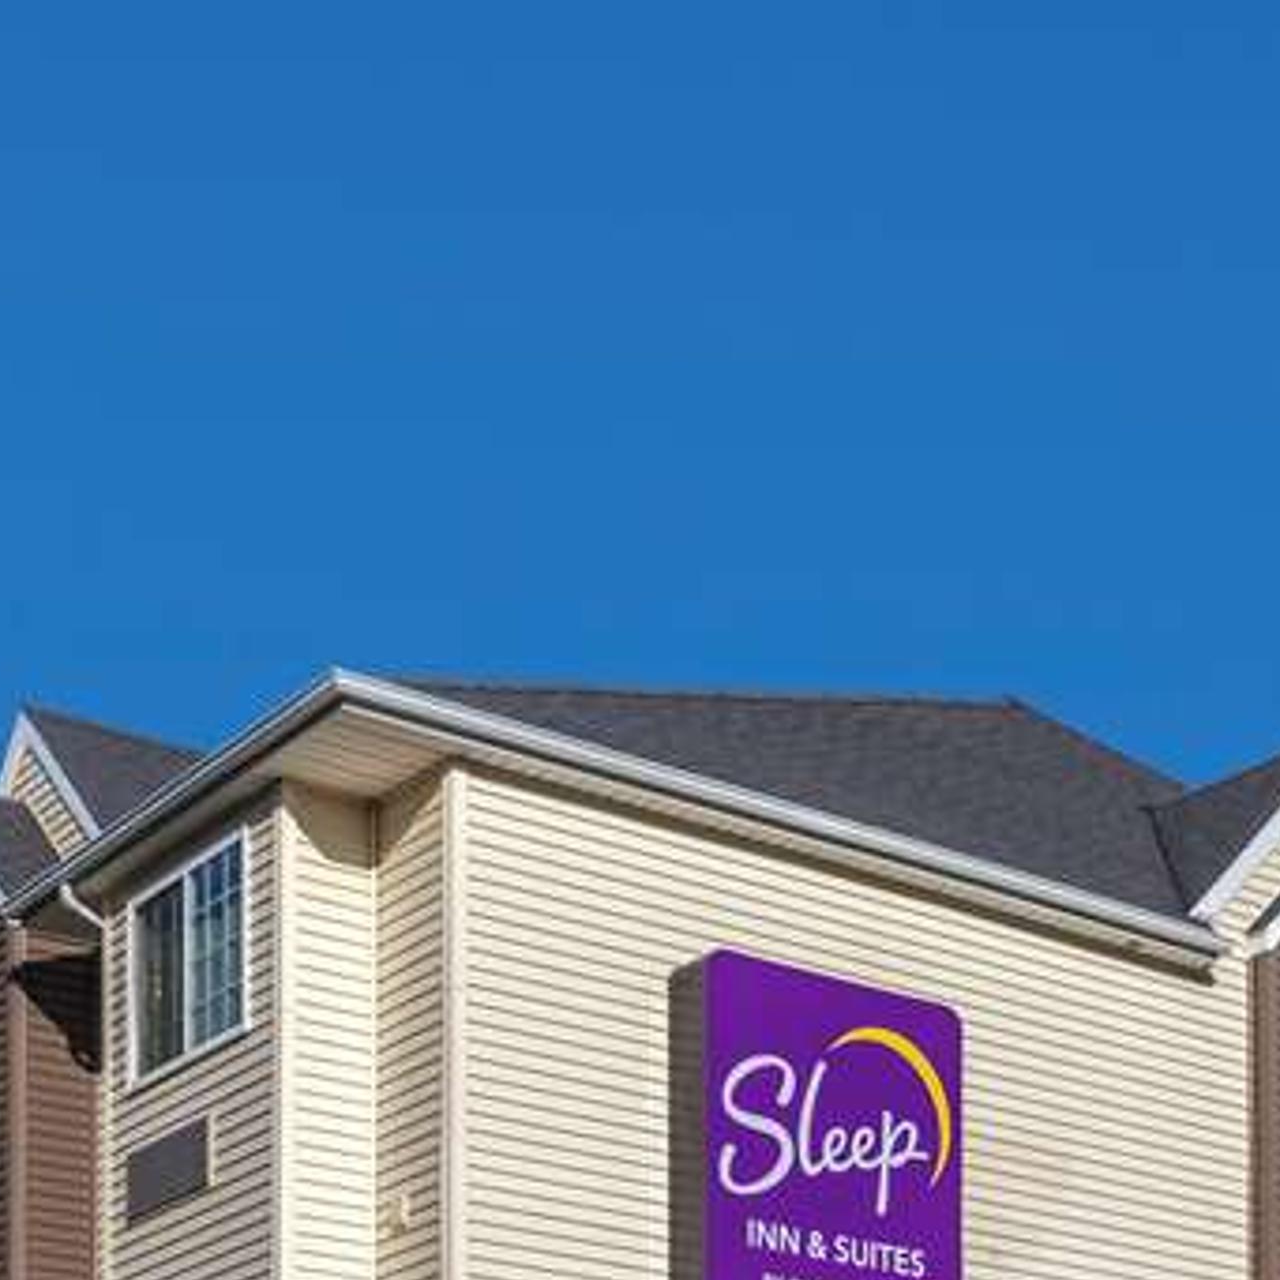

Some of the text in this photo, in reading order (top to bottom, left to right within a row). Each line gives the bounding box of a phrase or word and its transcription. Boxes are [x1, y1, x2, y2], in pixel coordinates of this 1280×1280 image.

[719, 1054, 929, 1215] Sleep
[746, 1218, 926, 1279] INN & SUITES
